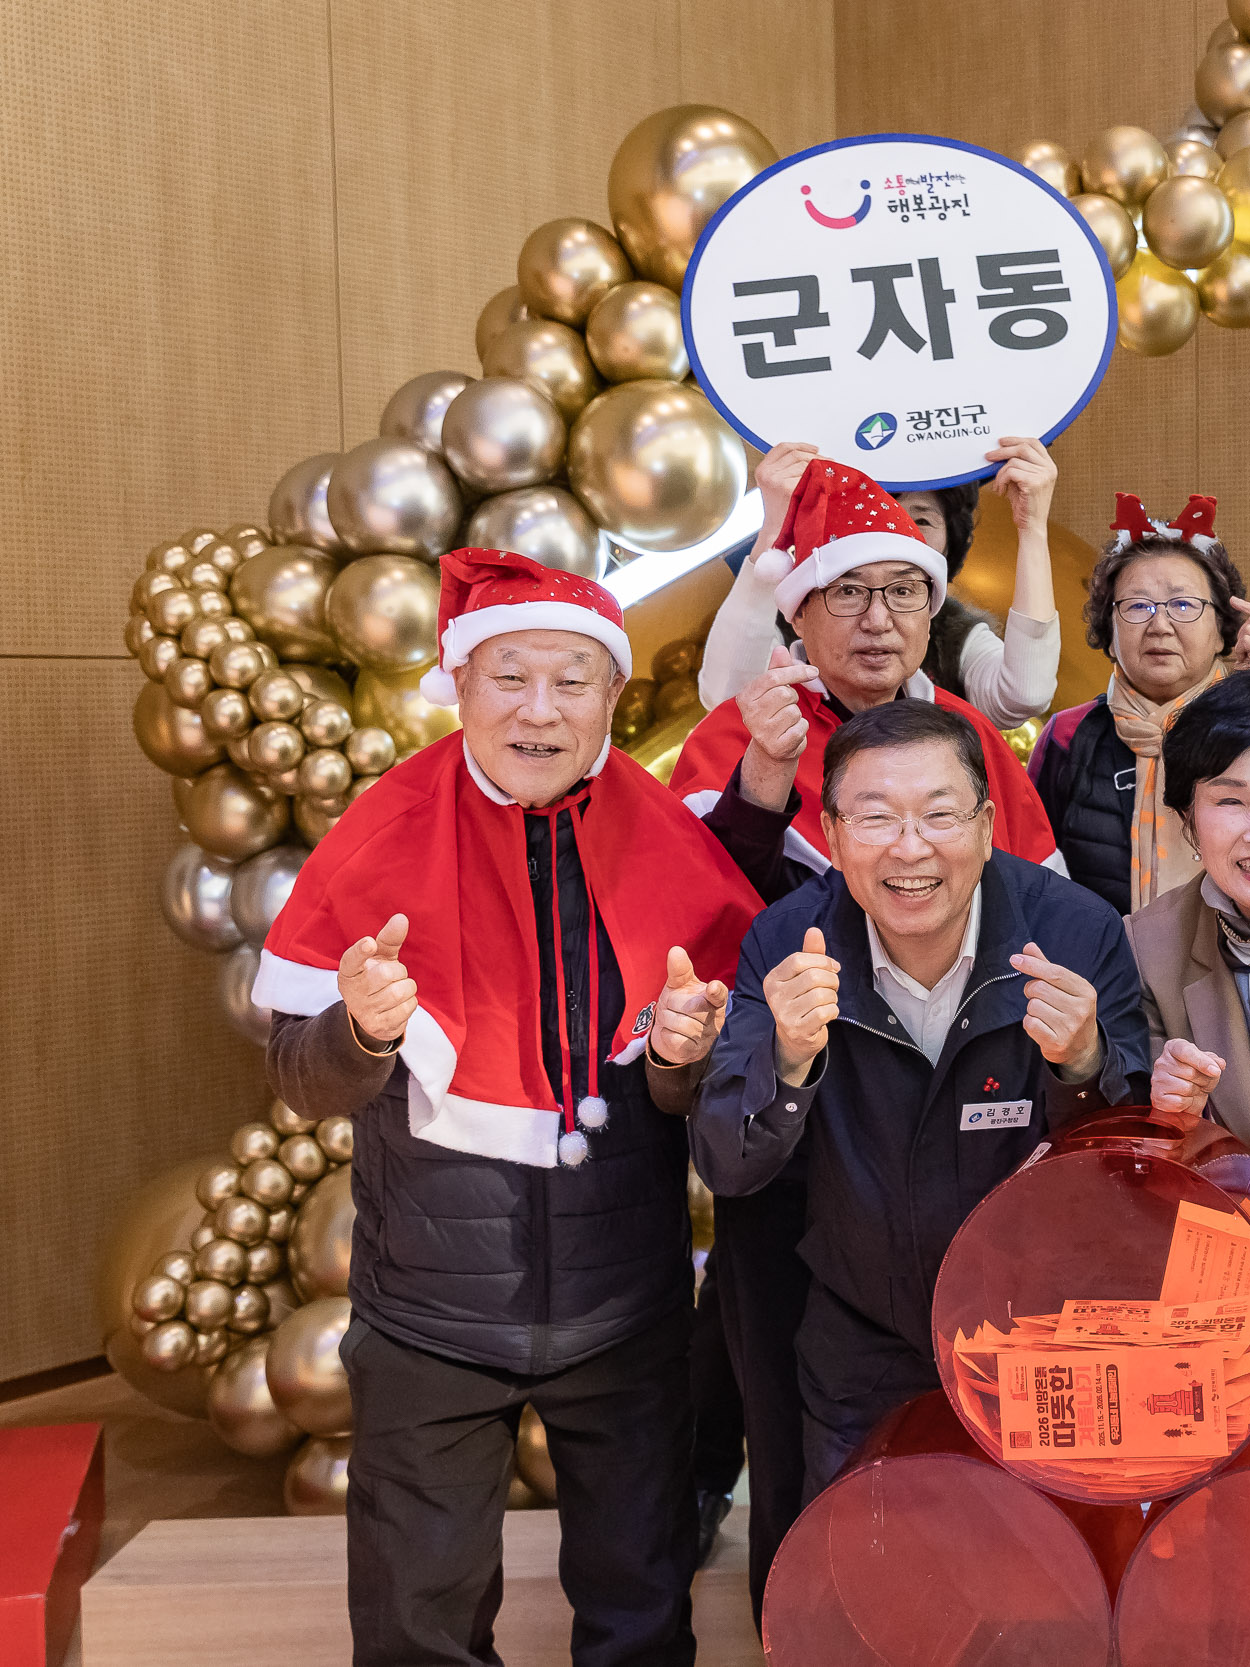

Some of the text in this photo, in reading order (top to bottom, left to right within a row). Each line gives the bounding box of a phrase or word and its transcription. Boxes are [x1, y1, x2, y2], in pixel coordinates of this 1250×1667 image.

[887, 193, 971, 223] 행복광진
[732, 248, 1072, 379] 군자동
[905, 404, 988, 431] 광진구
[906, 425, 991, 443] GWANGJIN-GU
[1034, 1366, 1049, 1447] 2026 희망온돌
[1048, 1365, 1076, 1448] 따뜻한
[1074, 1366, 1095, 1447] 겨울나기
